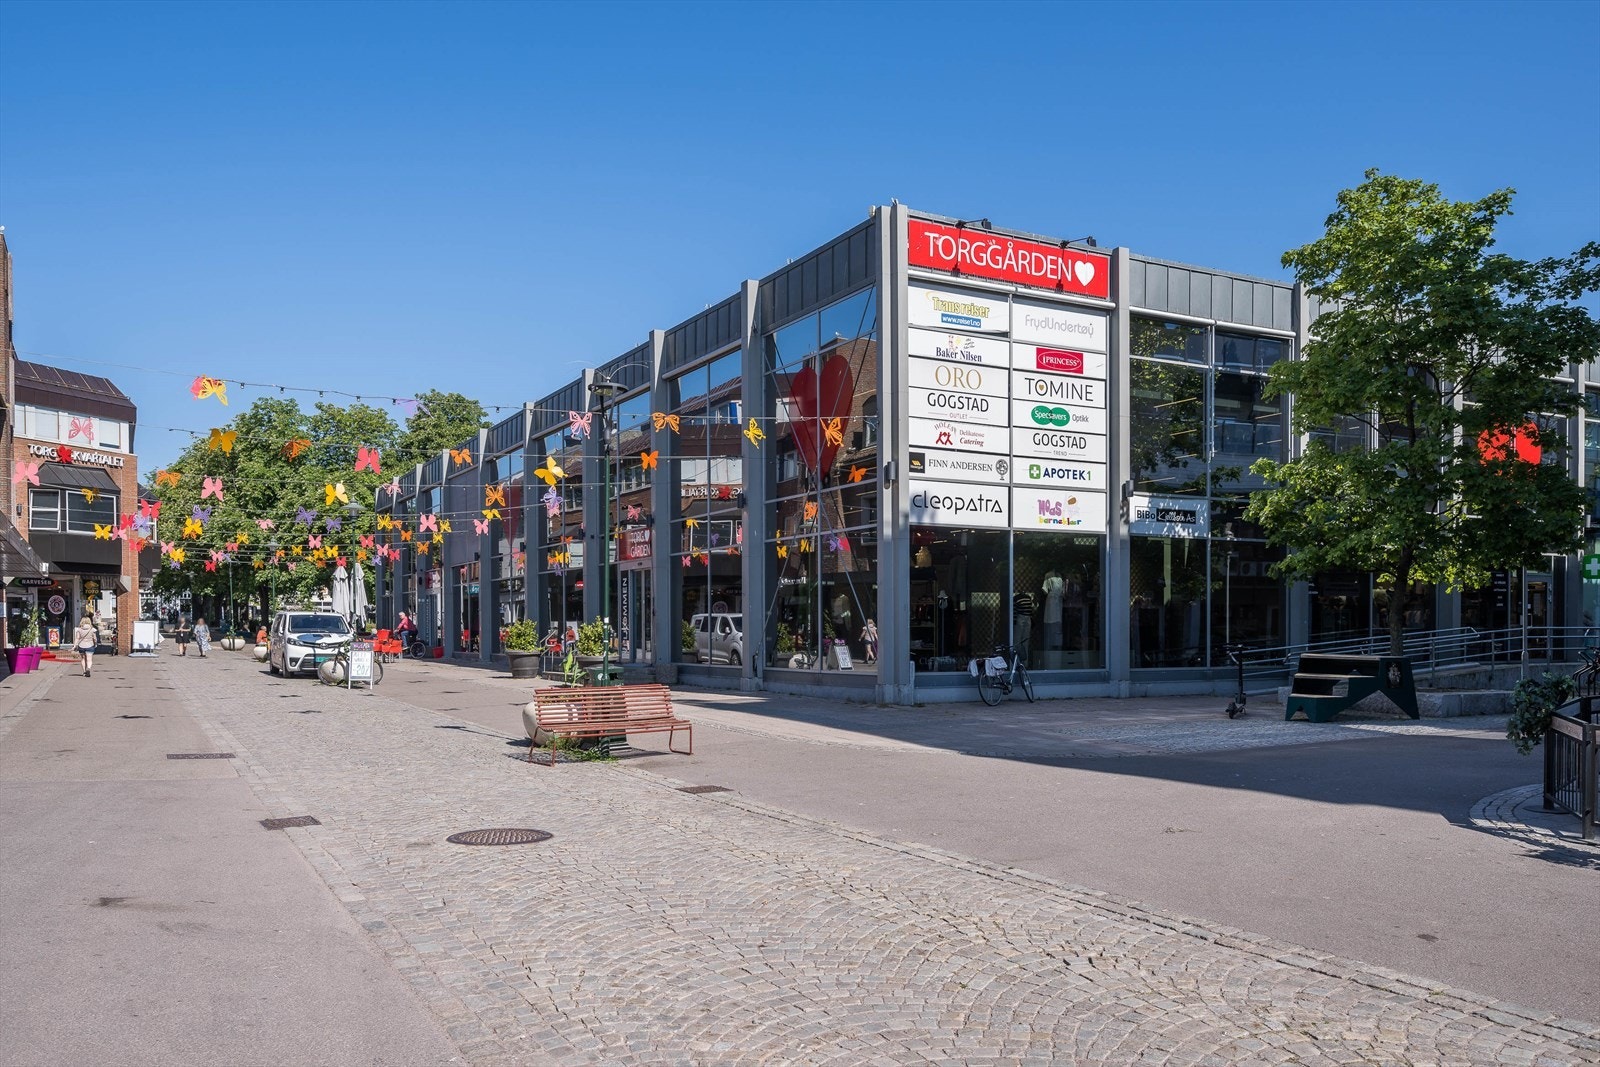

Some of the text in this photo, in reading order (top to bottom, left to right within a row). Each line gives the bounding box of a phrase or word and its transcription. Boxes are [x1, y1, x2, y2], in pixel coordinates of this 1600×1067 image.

[923, 231, 1072, 282] TORGGÅRDEN
[936, 346, 982, 362] Baker Nilsen
[1045, 356, 1078, 367] PRINCESS
[935, 365, 982, 390] ORO
[1024, 377, 1094, 402] TOMINE
[927, 392, 989, 412] GOGSTAD
[949, 412, 968, 420] OUTLET
[1034, 409, 1089, 423] Specsavers Optikk
[959, 437, 985, 447] Catering
[1032, 432, 1087, 450] GOGSTAD
[27, 443, 57, 458] TORG
[928, 458, 948, 468] FINN
[950, 461, 993, 472] ANDERSEN
[912, 490, 1003, 515] cleopatra
[1136, 509, 1156, 520] BiBo
[630, 530, 644, 543] TORG
[630, 544, 651, 557] GÅRDEN
